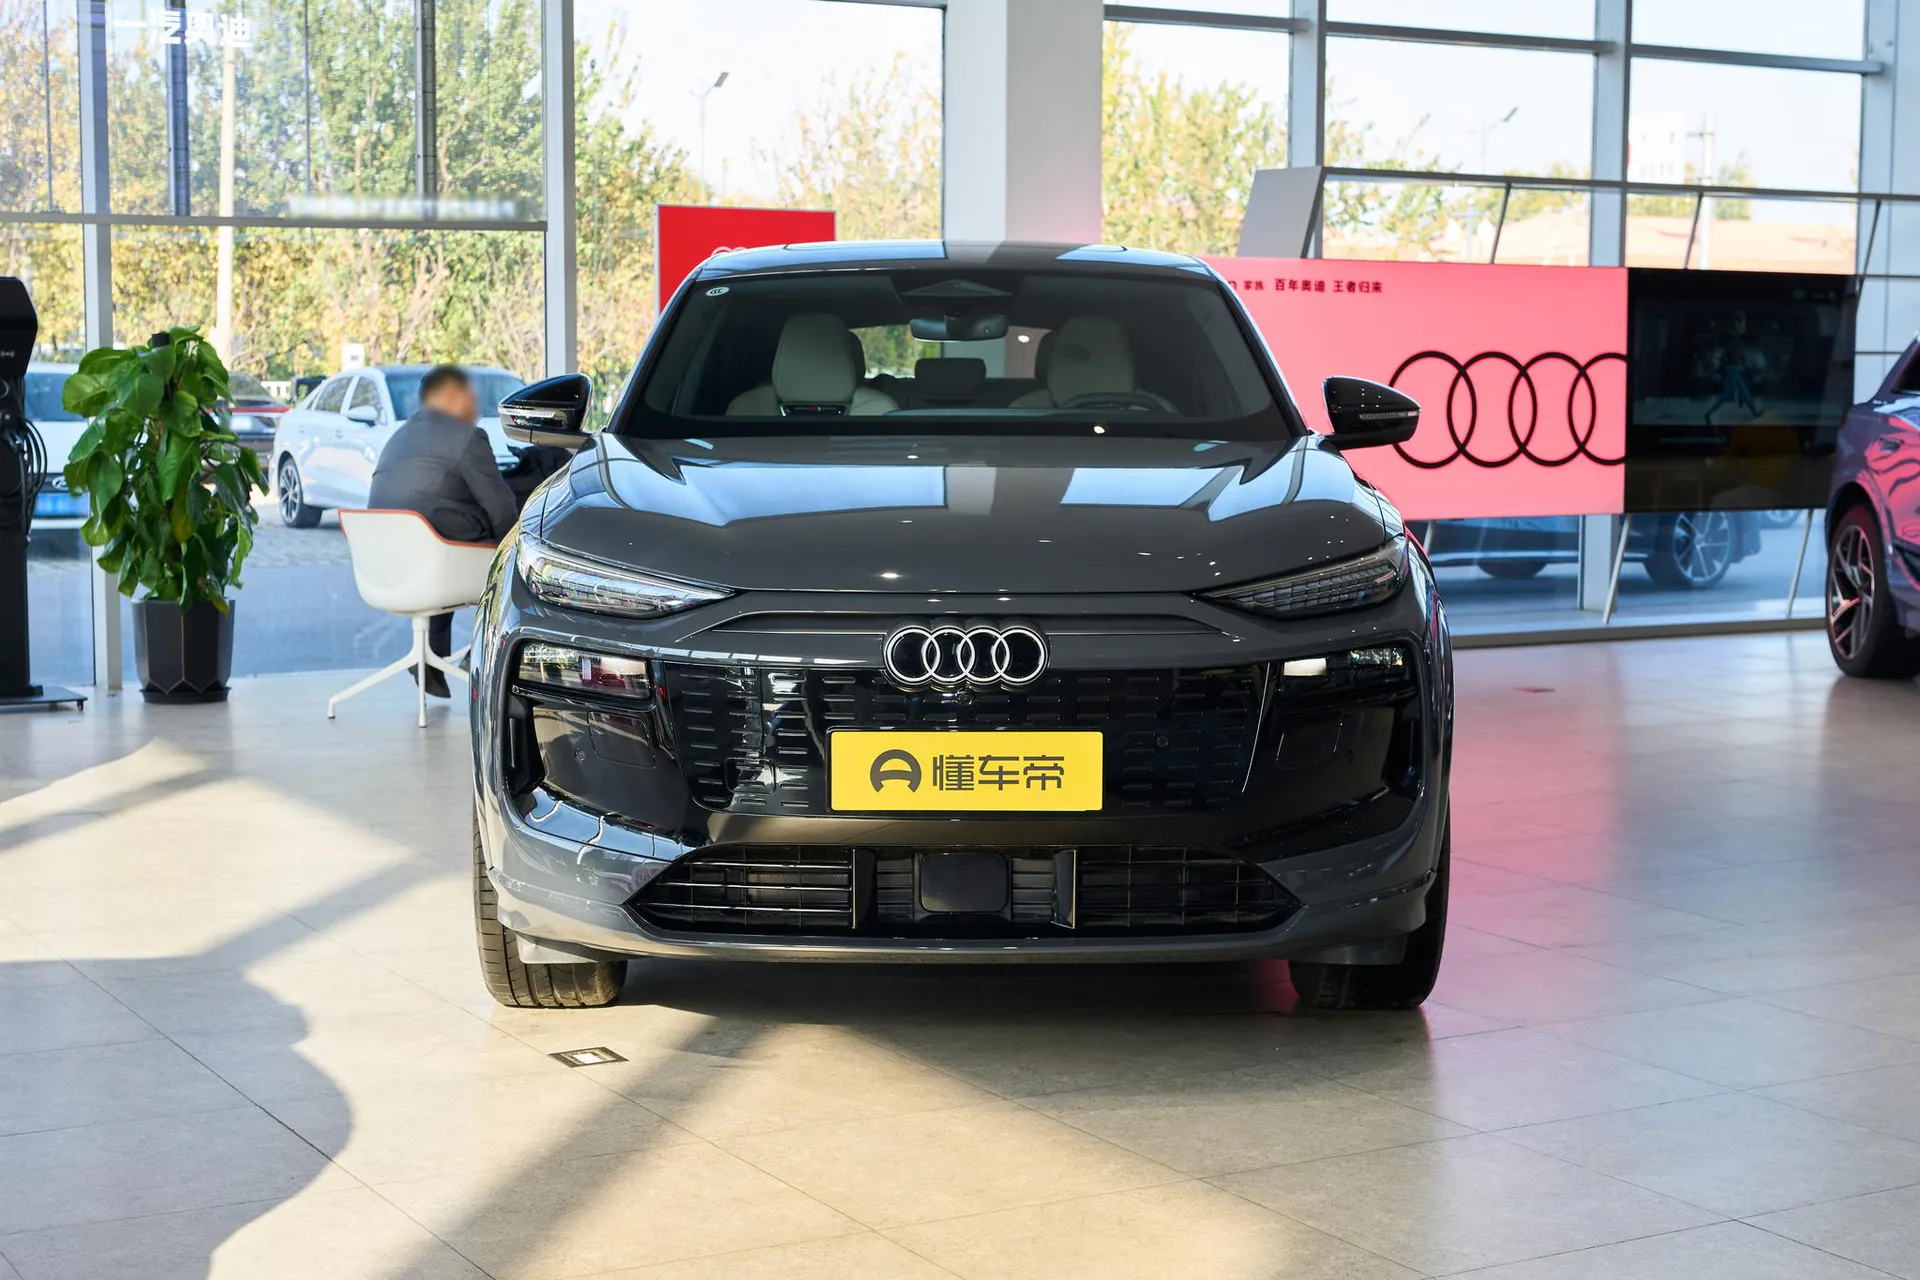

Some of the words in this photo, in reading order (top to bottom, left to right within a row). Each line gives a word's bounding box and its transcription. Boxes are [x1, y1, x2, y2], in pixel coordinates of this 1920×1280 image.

[1275, 279, 1325, 293] 百年奥迪
[1333, 280, 1383, 294] 王者归来
[932, 755, 1065, 791] 懂车帝
